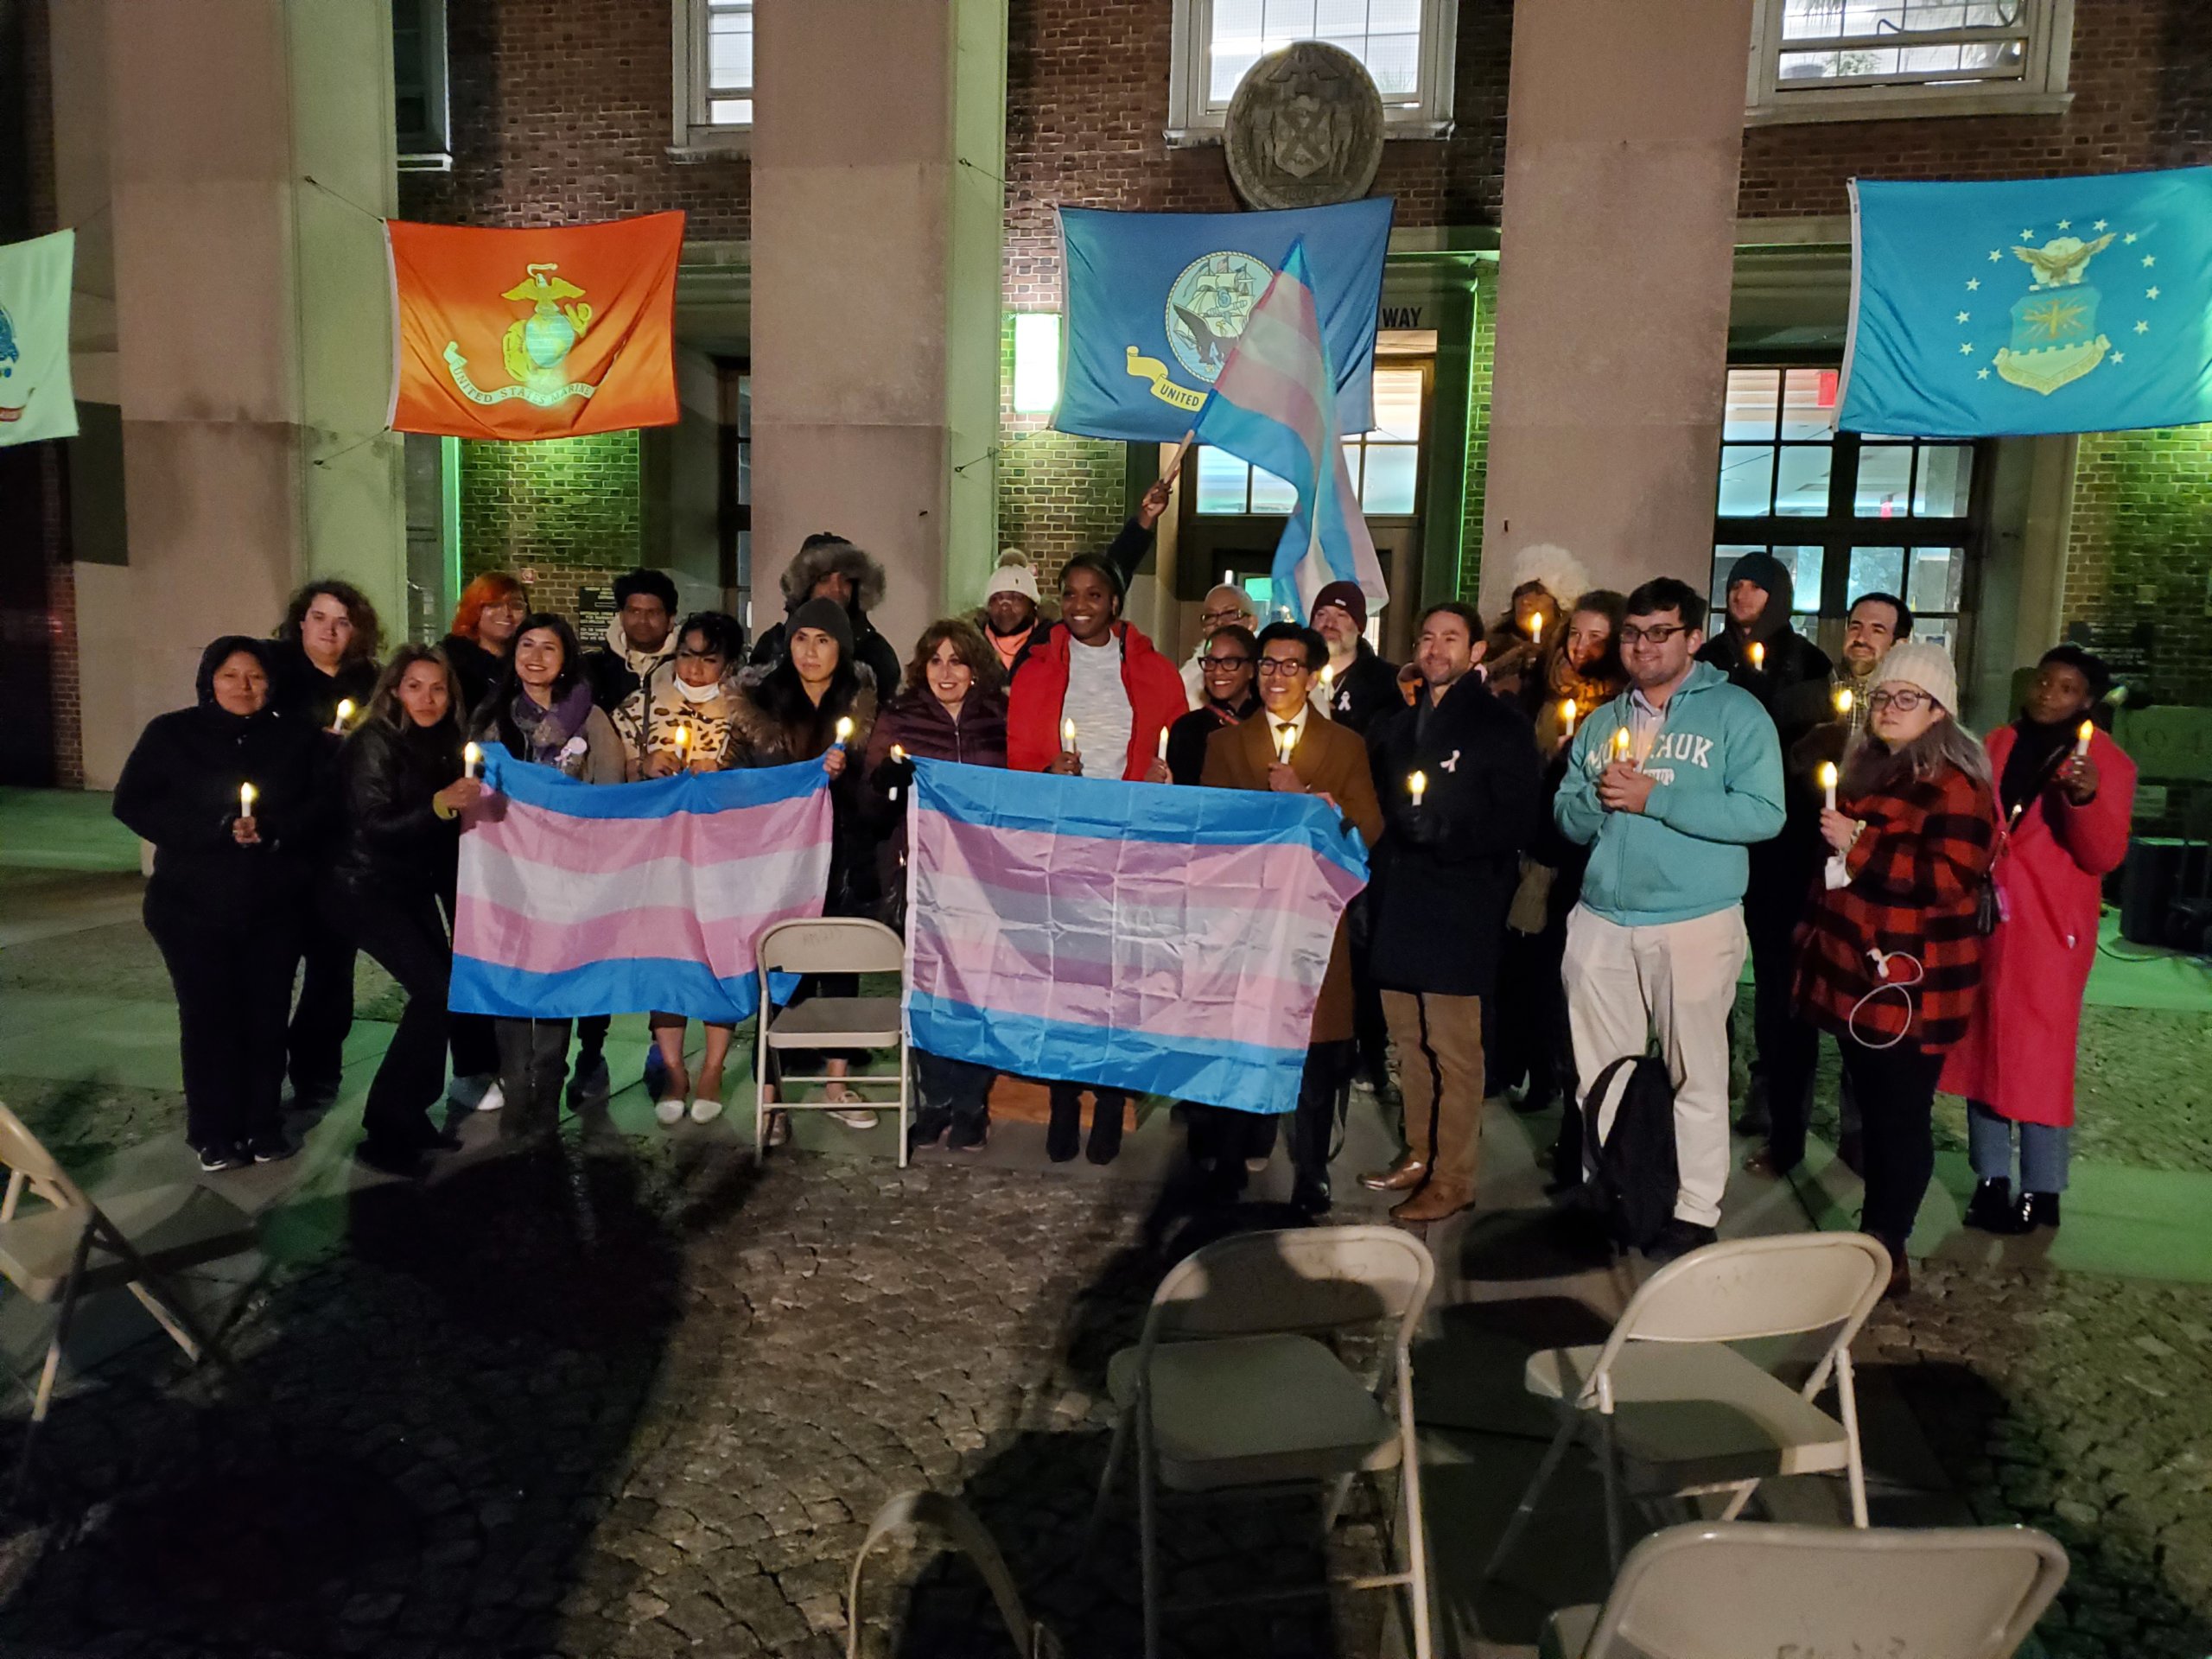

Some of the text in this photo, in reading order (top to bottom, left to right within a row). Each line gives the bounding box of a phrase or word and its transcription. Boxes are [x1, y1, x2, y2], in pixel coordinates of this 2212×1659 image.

[1382, 307, 1422, 327] WAY
[453, 366, 591, 404] UNITED STATES MARINE
[1160, 384, 1199, 407] UNITED
[1583, 733, 1713, 777] MOAUK
